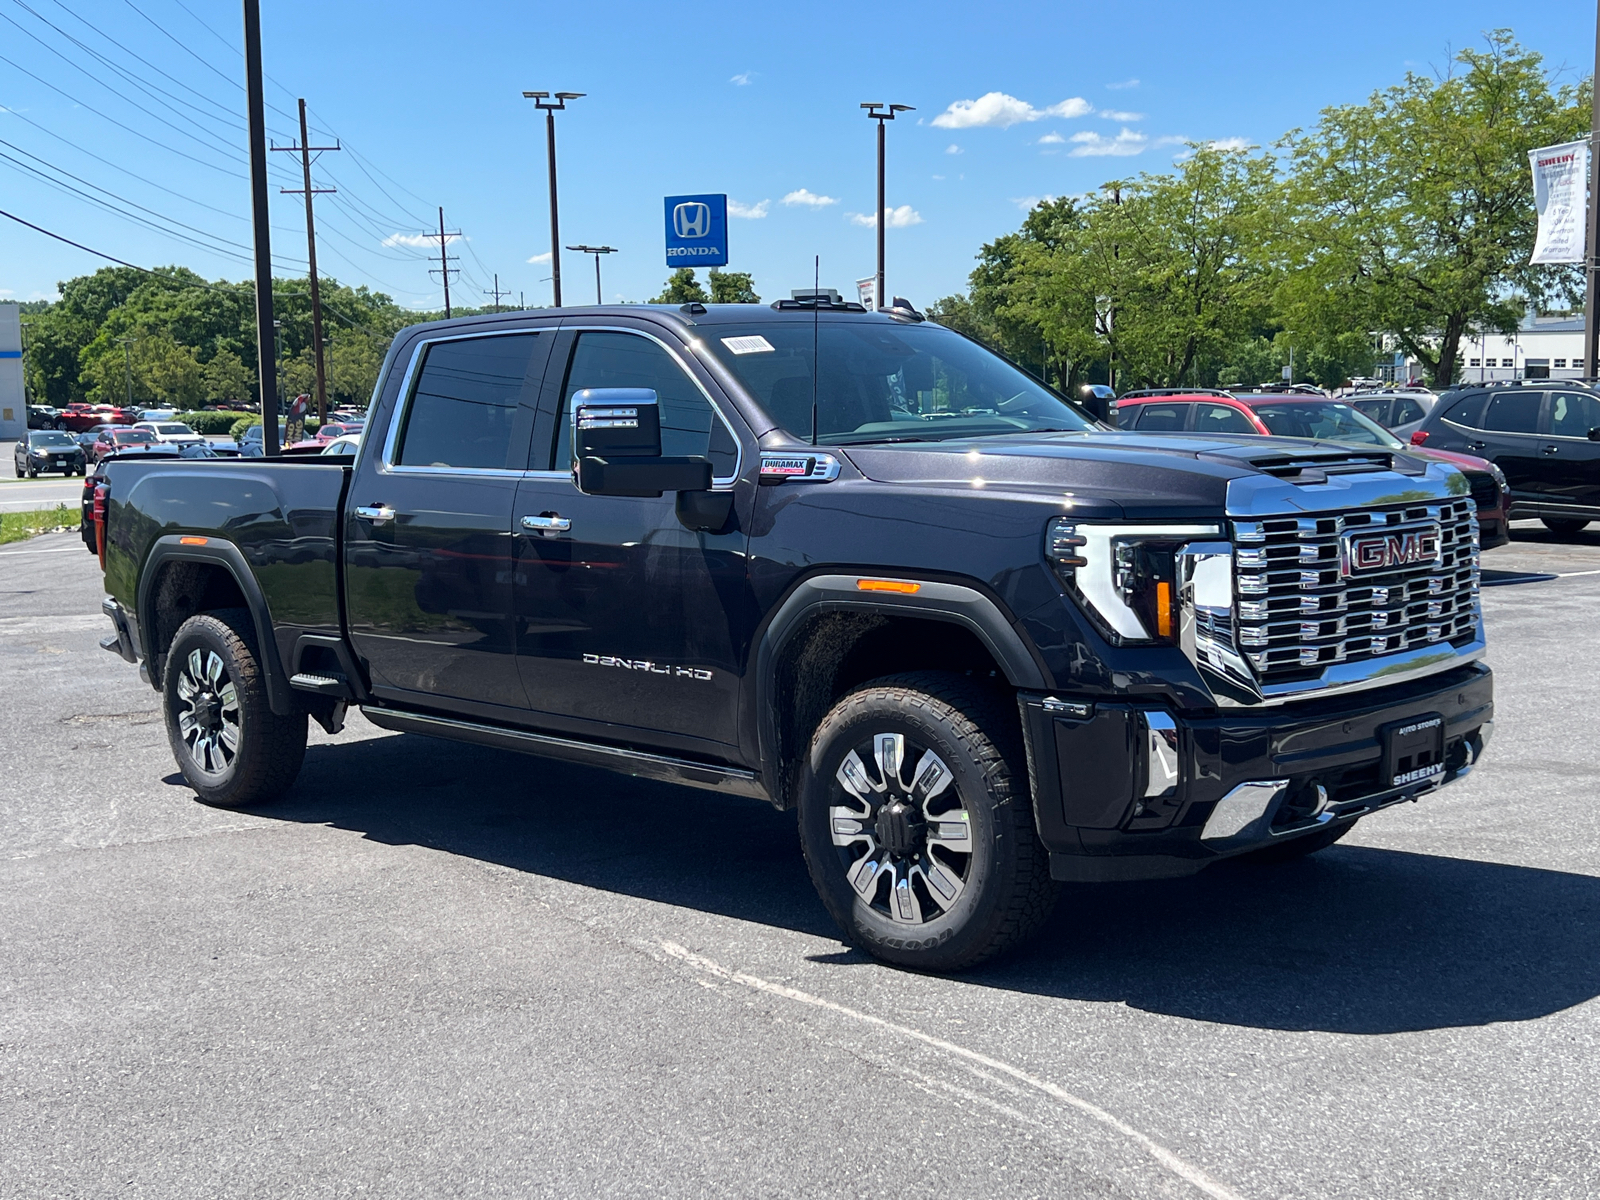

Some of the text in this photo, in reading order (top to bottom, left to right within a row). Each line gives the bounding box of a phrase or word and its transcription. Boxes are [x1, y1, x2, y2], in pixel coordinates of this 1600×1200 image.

[1538, 153, 1575, 167] SHEEHY
[667, 246, 720, 257] HONDA
[764, 460, 804, 468] DURAMAX
[1352, 531, 1439, 570] GMC
[583, 653, 712, 680] DENALI HD
[1399, 718, 1441, 736] AUTO STORES
[838, 708, 966, 774] WRANGLER
[1393, 762, 1444, 785] SHEEHY
